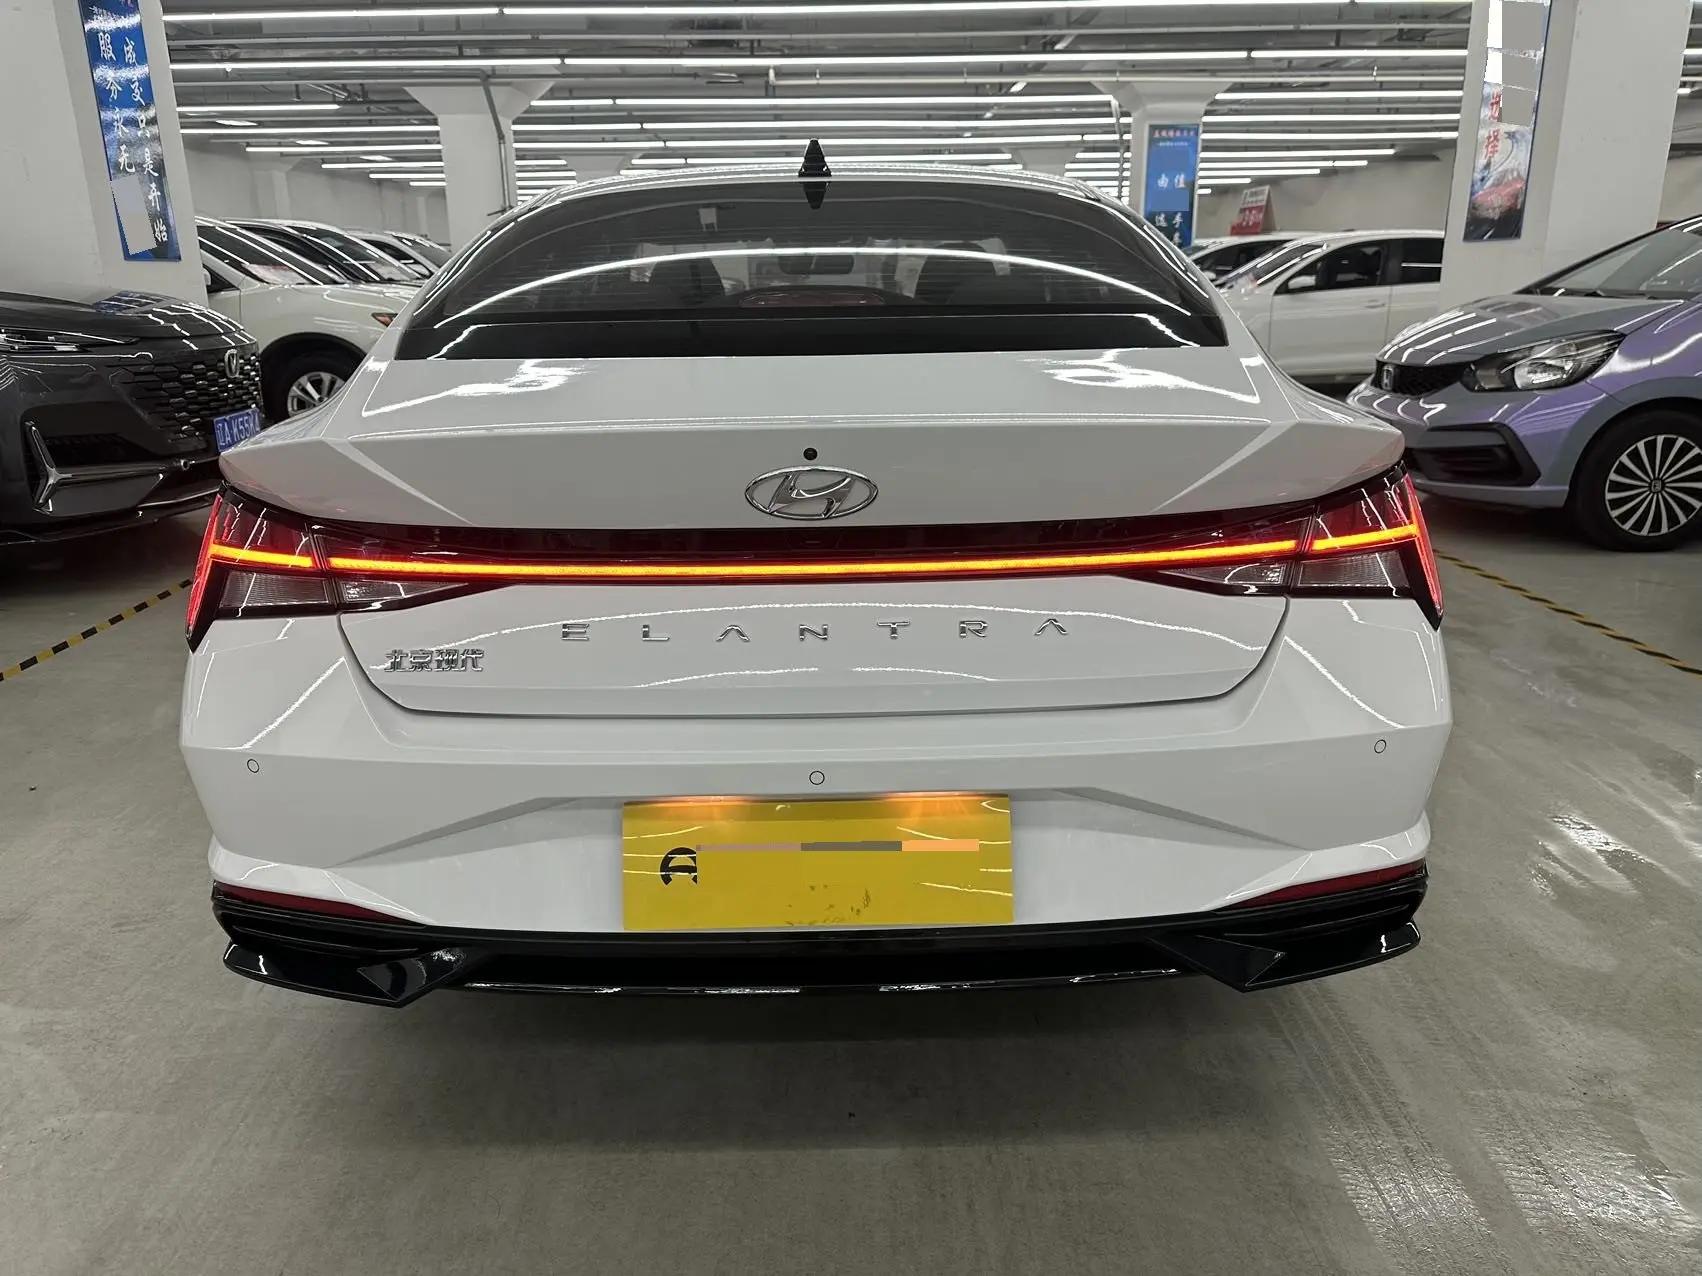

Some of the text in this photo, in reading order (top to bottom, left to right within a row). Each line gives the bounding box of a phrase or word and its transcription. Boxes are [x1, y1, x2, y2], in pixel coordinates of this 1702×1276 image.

[561, 618, 1068, 642] ELANTRA
[384, 648, 485, 672] 北京现代
